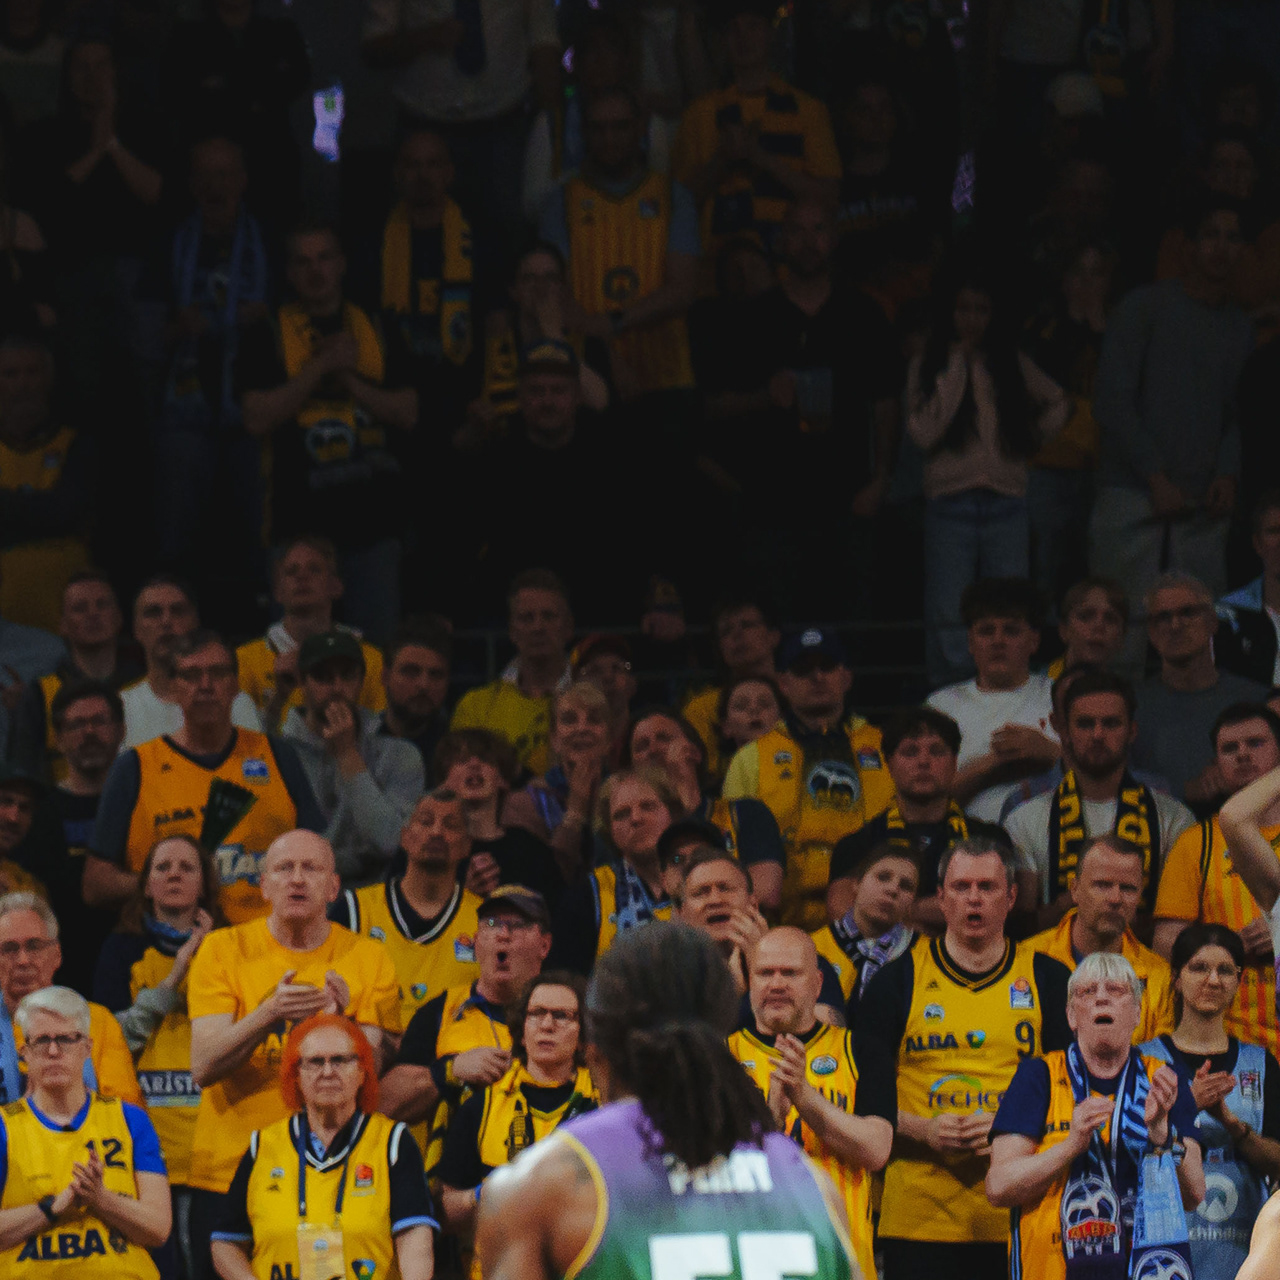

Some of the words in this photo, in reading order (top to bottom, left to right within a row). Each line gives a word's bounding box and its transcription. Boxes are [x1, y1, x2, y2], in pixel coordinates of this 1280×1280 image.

[905, 1033, 959, 1052] ALBA
[1014, 1020, 1035, 1057] 9
[16, 1228, 107, 1263] ALBA
